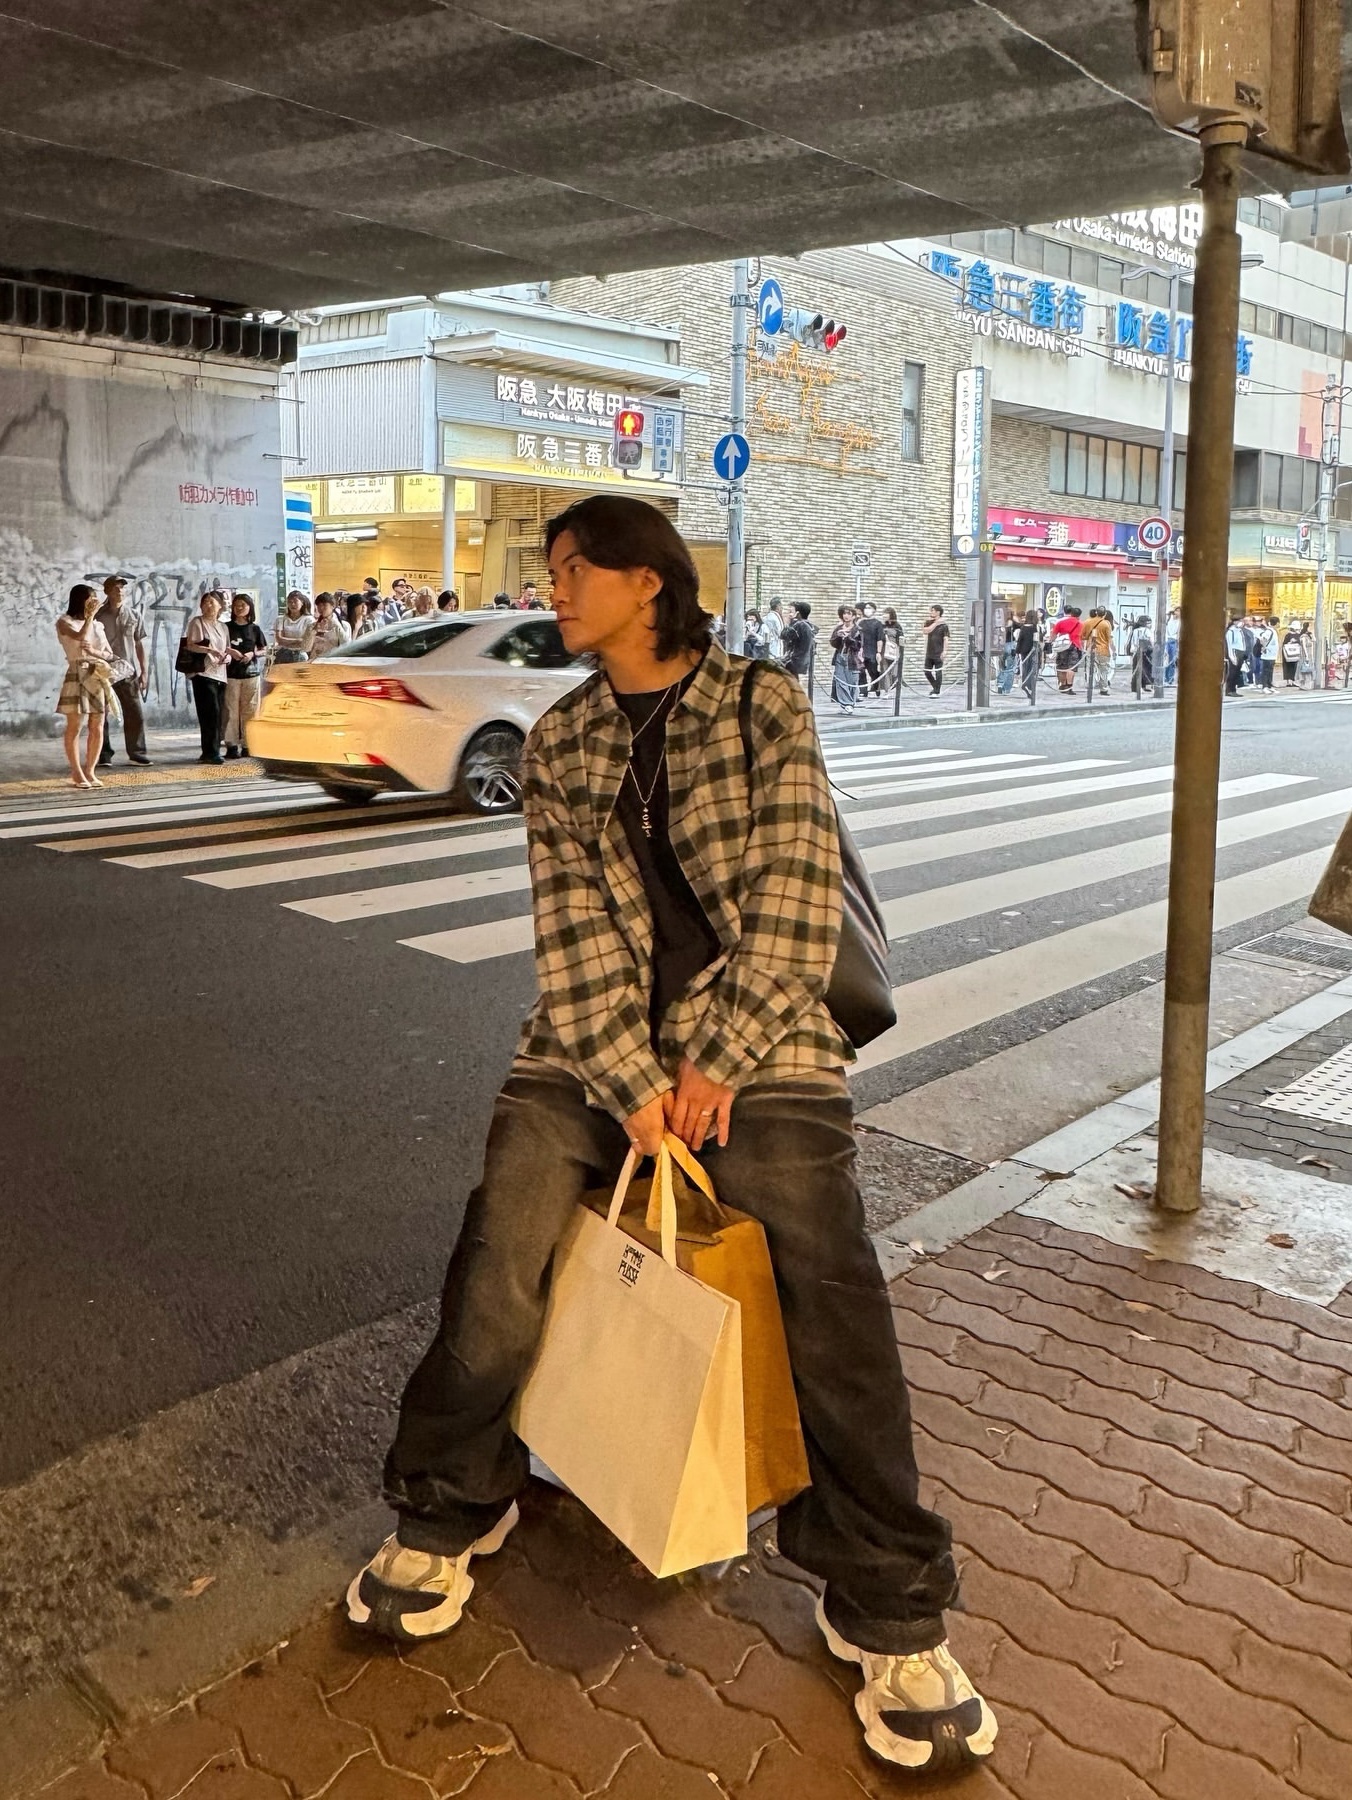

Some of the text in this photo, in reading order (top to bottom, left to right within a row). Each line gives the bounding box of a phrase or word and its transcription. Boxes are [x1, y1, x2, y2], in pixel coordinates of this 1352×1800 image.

[1156, 240, 1195, 270] Station
[497, 374, 538, 406] 阪急
[1145, 526, 1164, 541] 40
